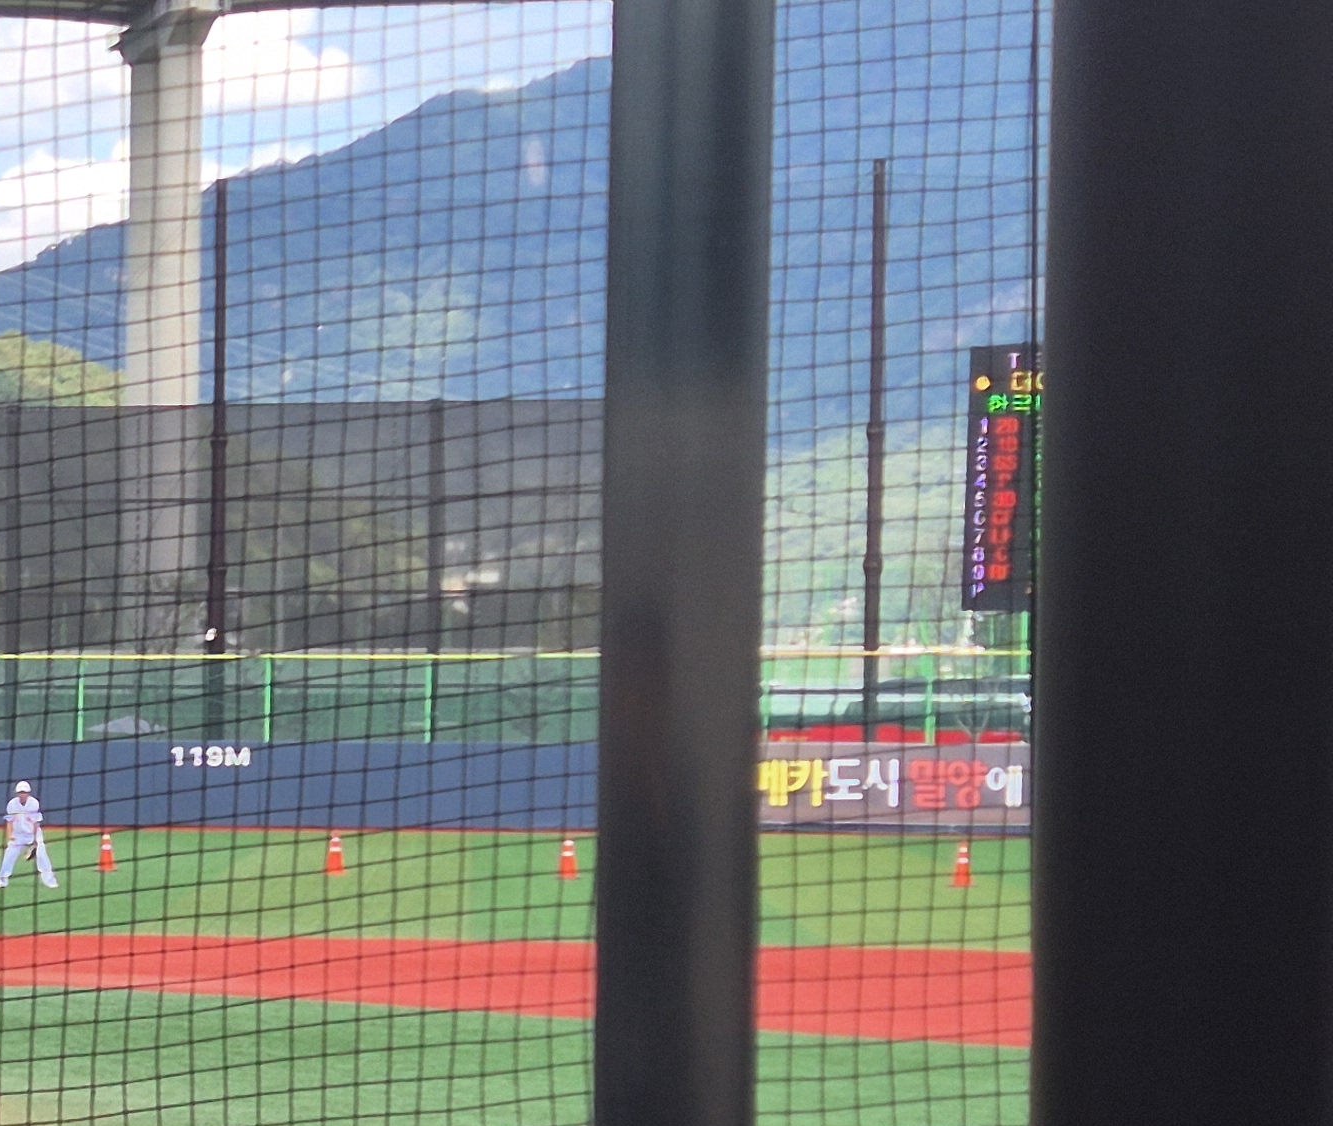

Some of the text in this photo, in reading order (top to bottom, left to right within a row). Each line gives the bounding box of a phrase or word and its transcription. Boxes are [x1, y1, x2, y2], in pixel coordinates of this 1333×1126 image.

[976, 437, 988, 453] 2
[975, 455, 987, 471] 3
[974, 473, 987, 489] 4
[974, 491, 986, 507] 5
[973, 510, 986, 525] 6
[973, 528, 985, 544] 7
[972, 547, 985, 562] 8
[170, 745, 252, 767] 119M
